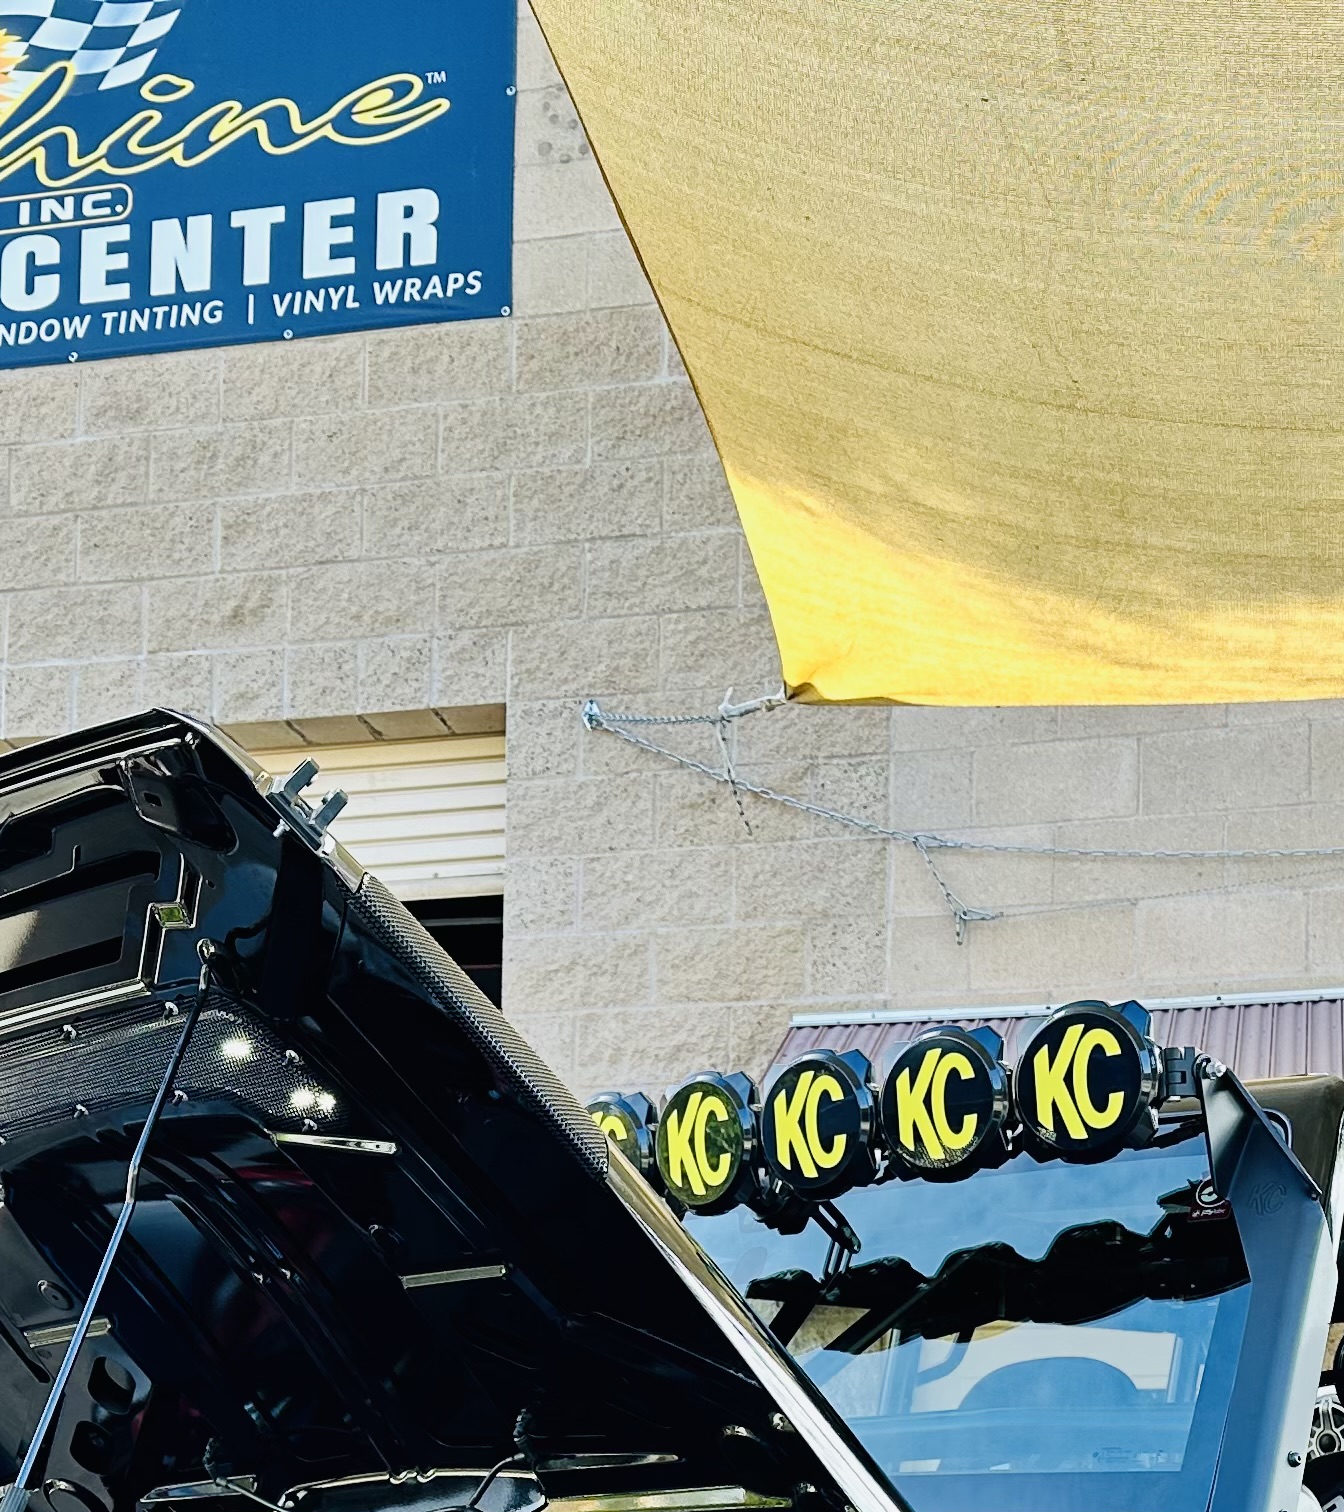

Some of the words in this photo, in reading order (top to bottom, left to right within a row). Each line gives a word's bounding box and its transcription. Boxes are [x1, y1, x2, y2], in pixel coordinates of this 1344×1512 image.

[18, 190, 125, 226] INC.
[102, 300, 225, 336] TINTING
[272, 285, 361, 318] VINYL
[372, 270, 484, 305] WRAPS
[773, 1069, 848, 1179] KC
[895, 1048, 979, 1160] KC
[1032, 1023, 1126, 1140] KC
[666, 1092, 732, 1196] KC
